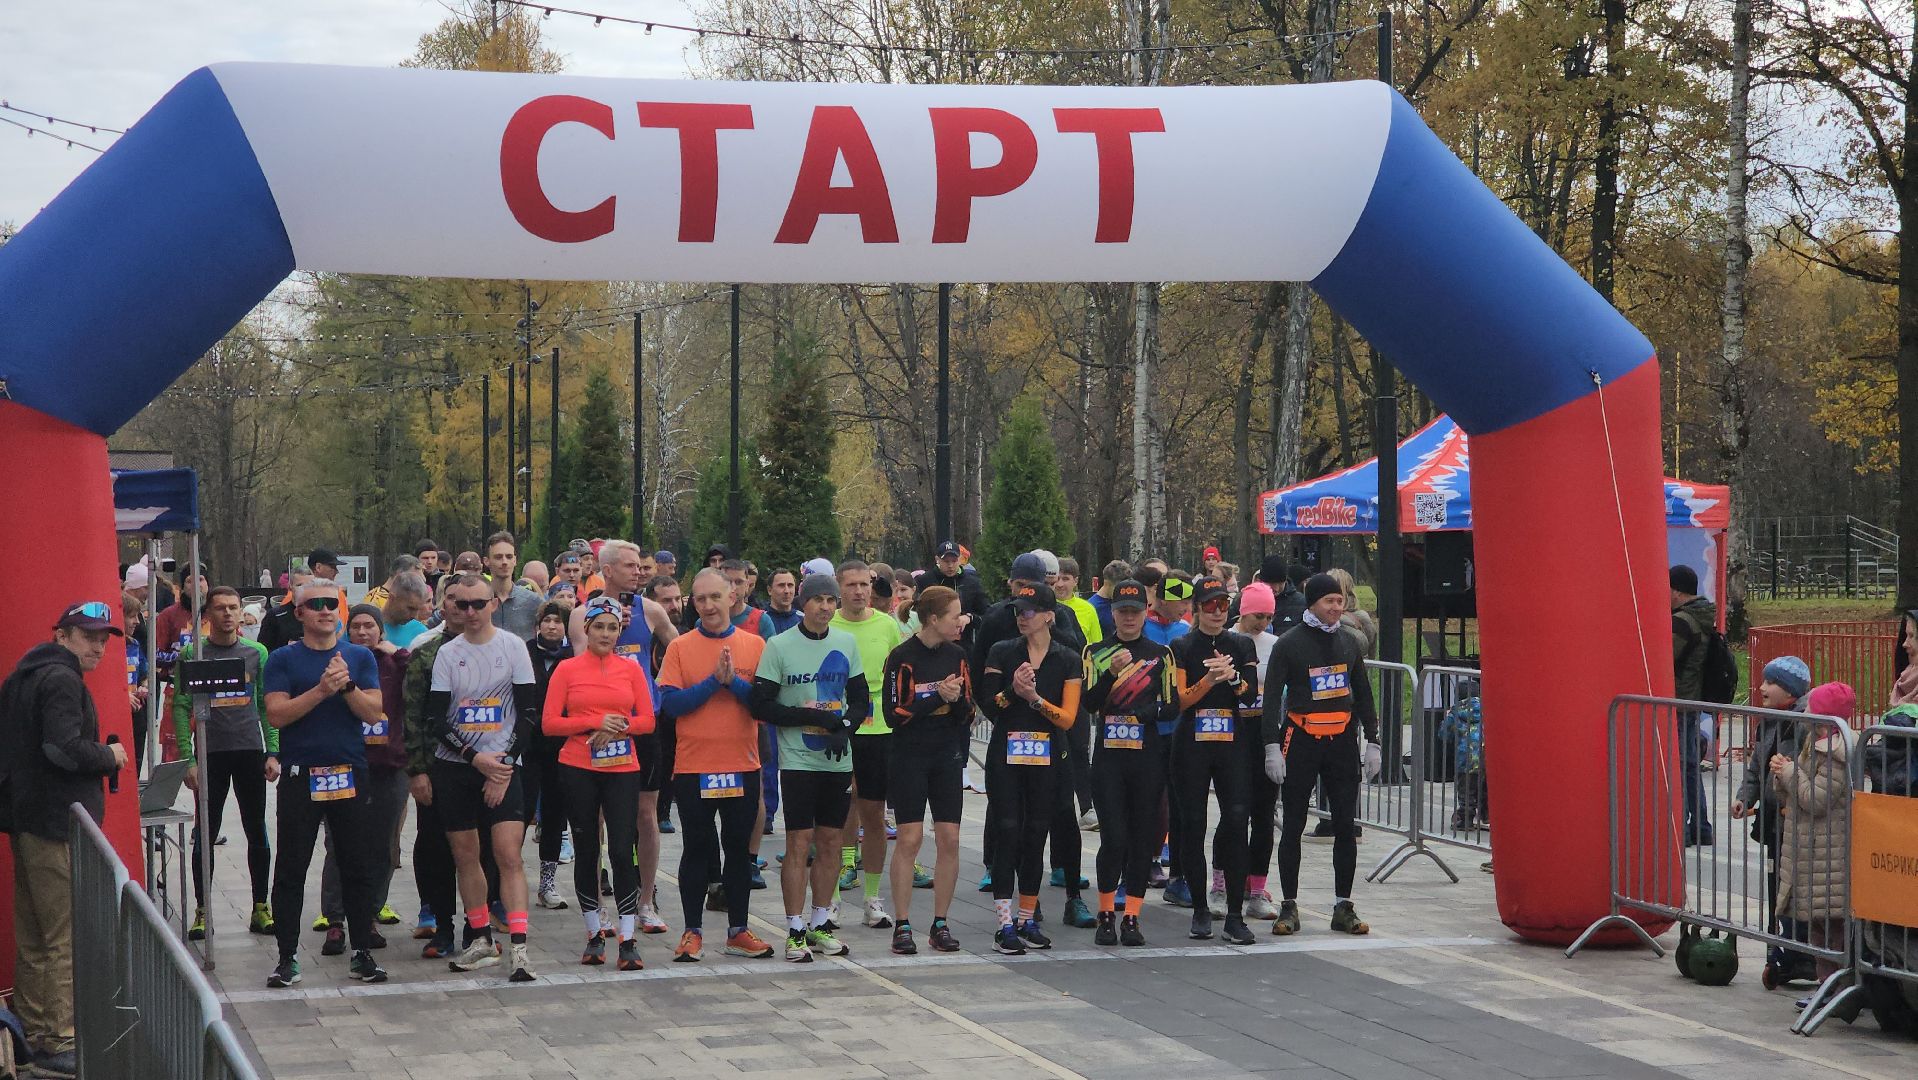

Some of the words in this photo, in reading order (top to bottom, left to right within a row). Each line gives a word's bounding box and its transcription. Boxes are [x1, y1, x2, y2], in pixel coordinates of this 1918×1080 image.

[500, 94, 1166, 244] СТАРТ
[1296, 496, 1357, 528] redBike
[1316, 674, 1345, 690] 242
[464, 707, 495, 722] 241
[362, 721, 383, 735] 76
[1108, 725, 1140, 739] 206
[1202, 718, 1228, 731] 251
[1013, 741, 1045, 755] 239
[316, 773, 349, 790] 225
[707, 773, 736, 788] 211
